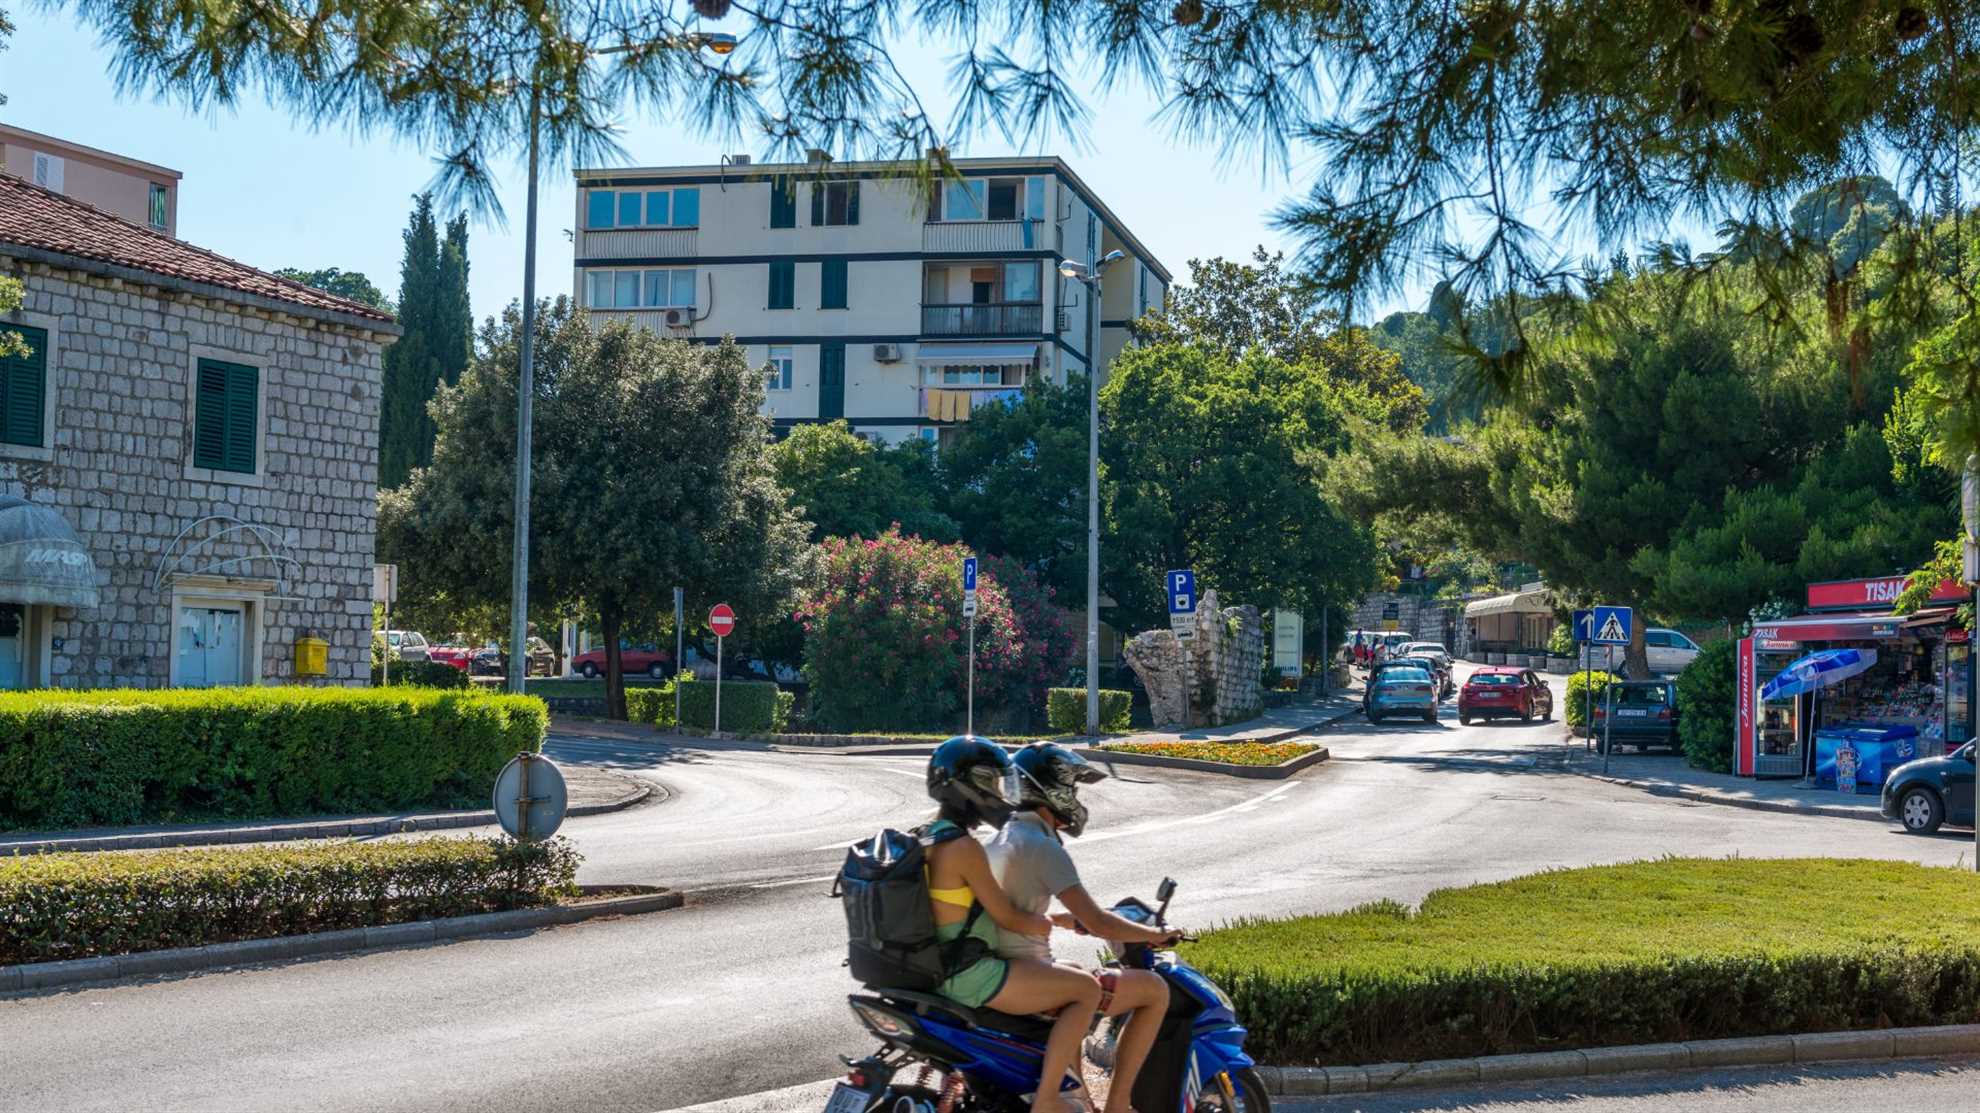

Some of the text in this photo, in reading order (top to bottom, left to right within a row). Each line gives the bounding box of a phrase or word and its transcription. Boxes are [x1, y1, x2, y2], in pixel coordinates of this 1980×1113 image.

[967, 564, 973, 584] P
[1175, 574, 1186, 591] P
[1865, 580, 1907, 600] TISAK
